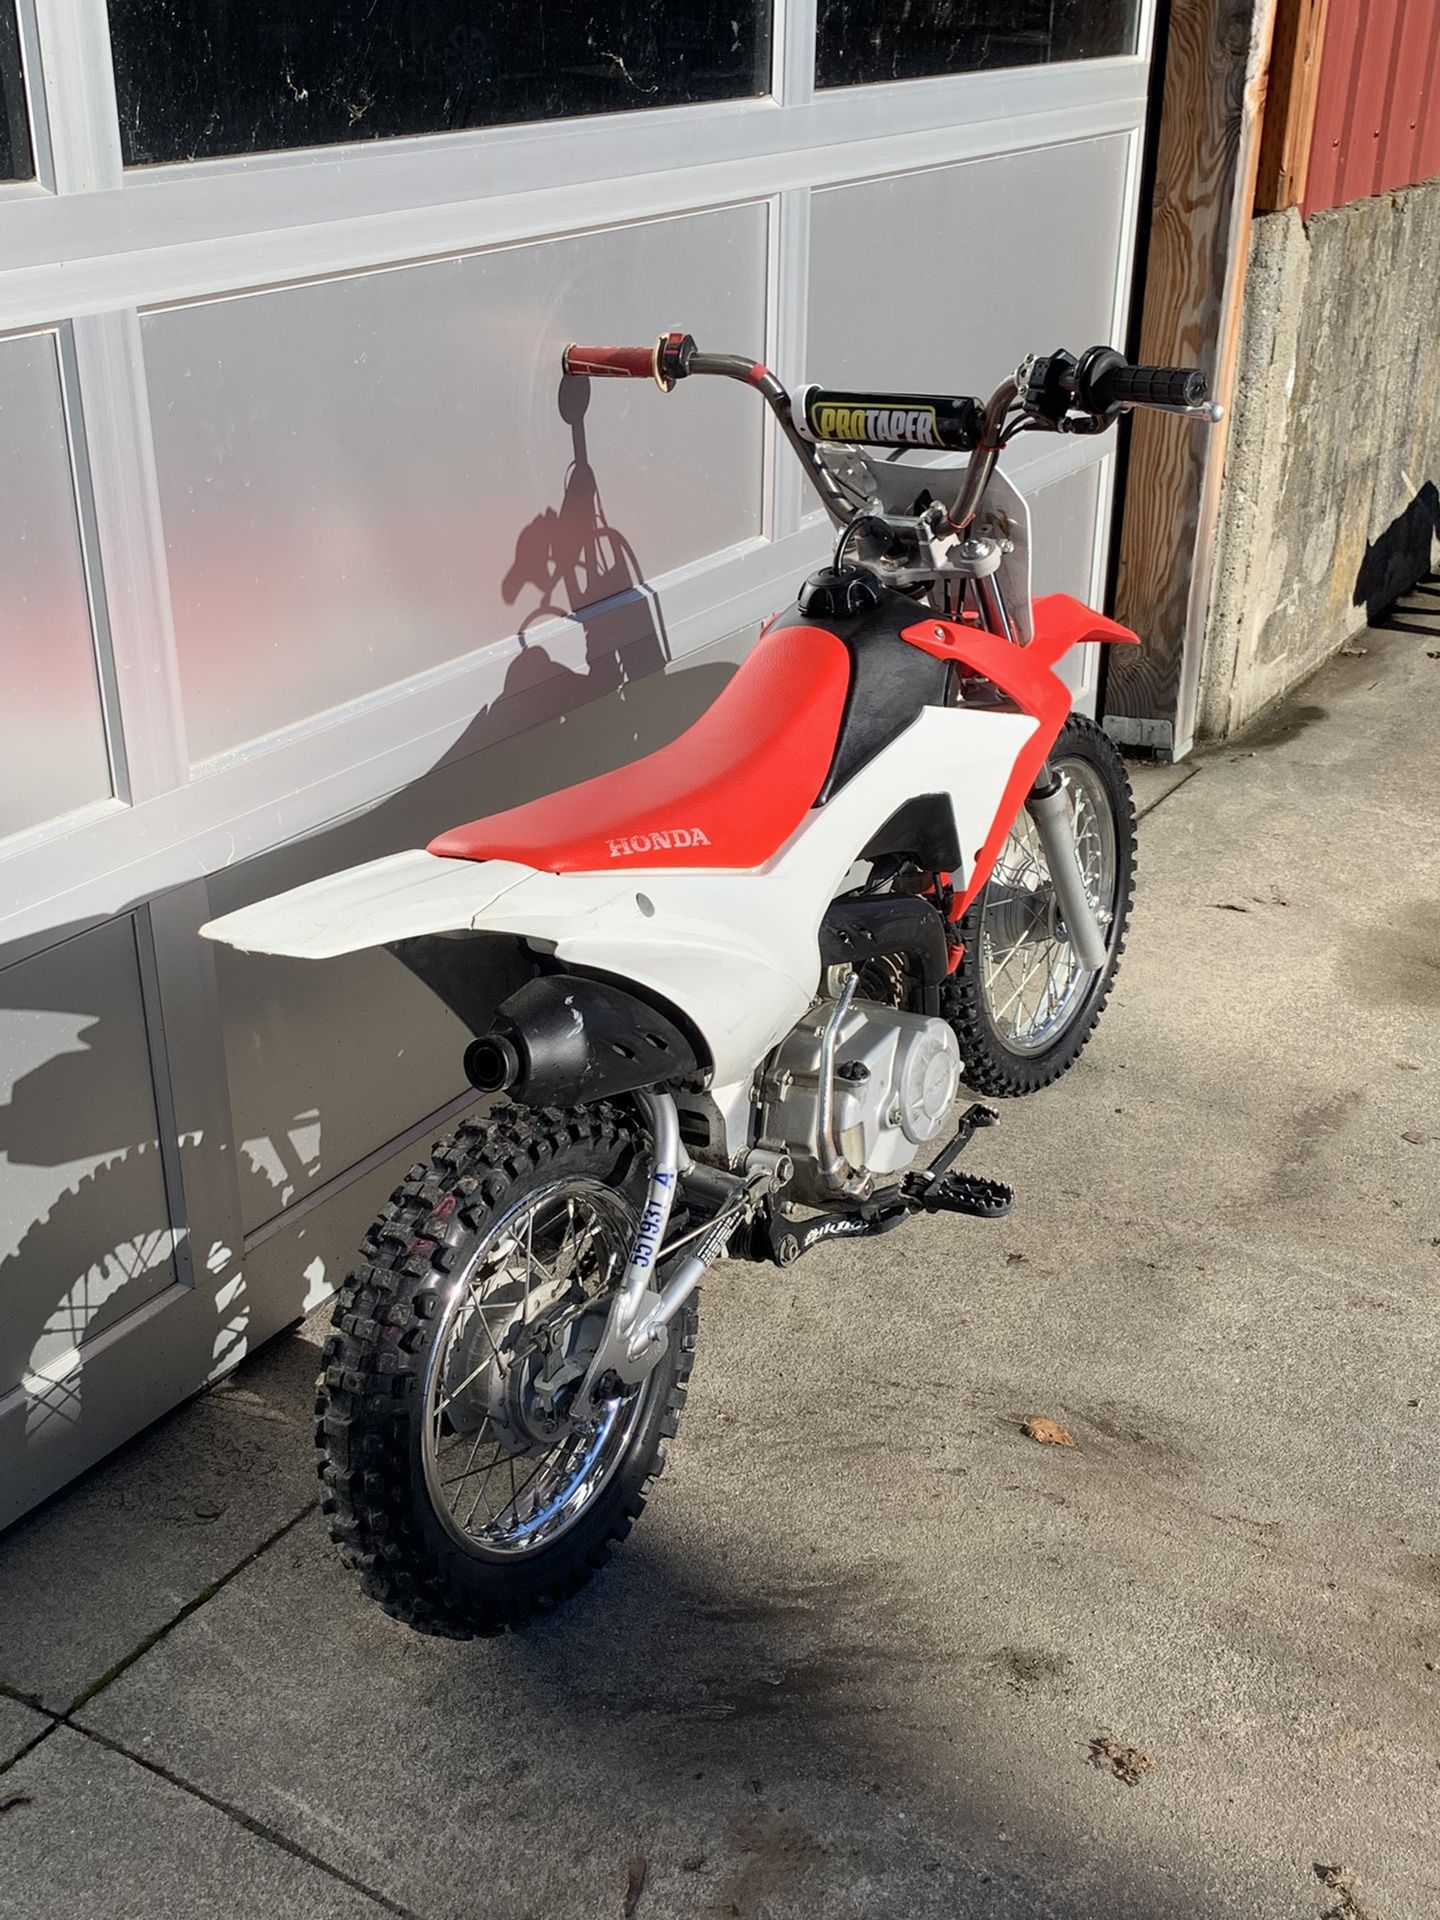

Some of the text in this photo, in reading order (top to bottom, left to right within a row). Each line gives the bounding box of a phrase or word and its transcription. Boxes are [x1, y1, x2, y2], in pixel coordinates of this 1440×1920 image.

[820, 408, 936, 445] PROTAPER
[605, 827, 712, 858] HONDA
[630, 1172, 674, 1268] 551931 A
